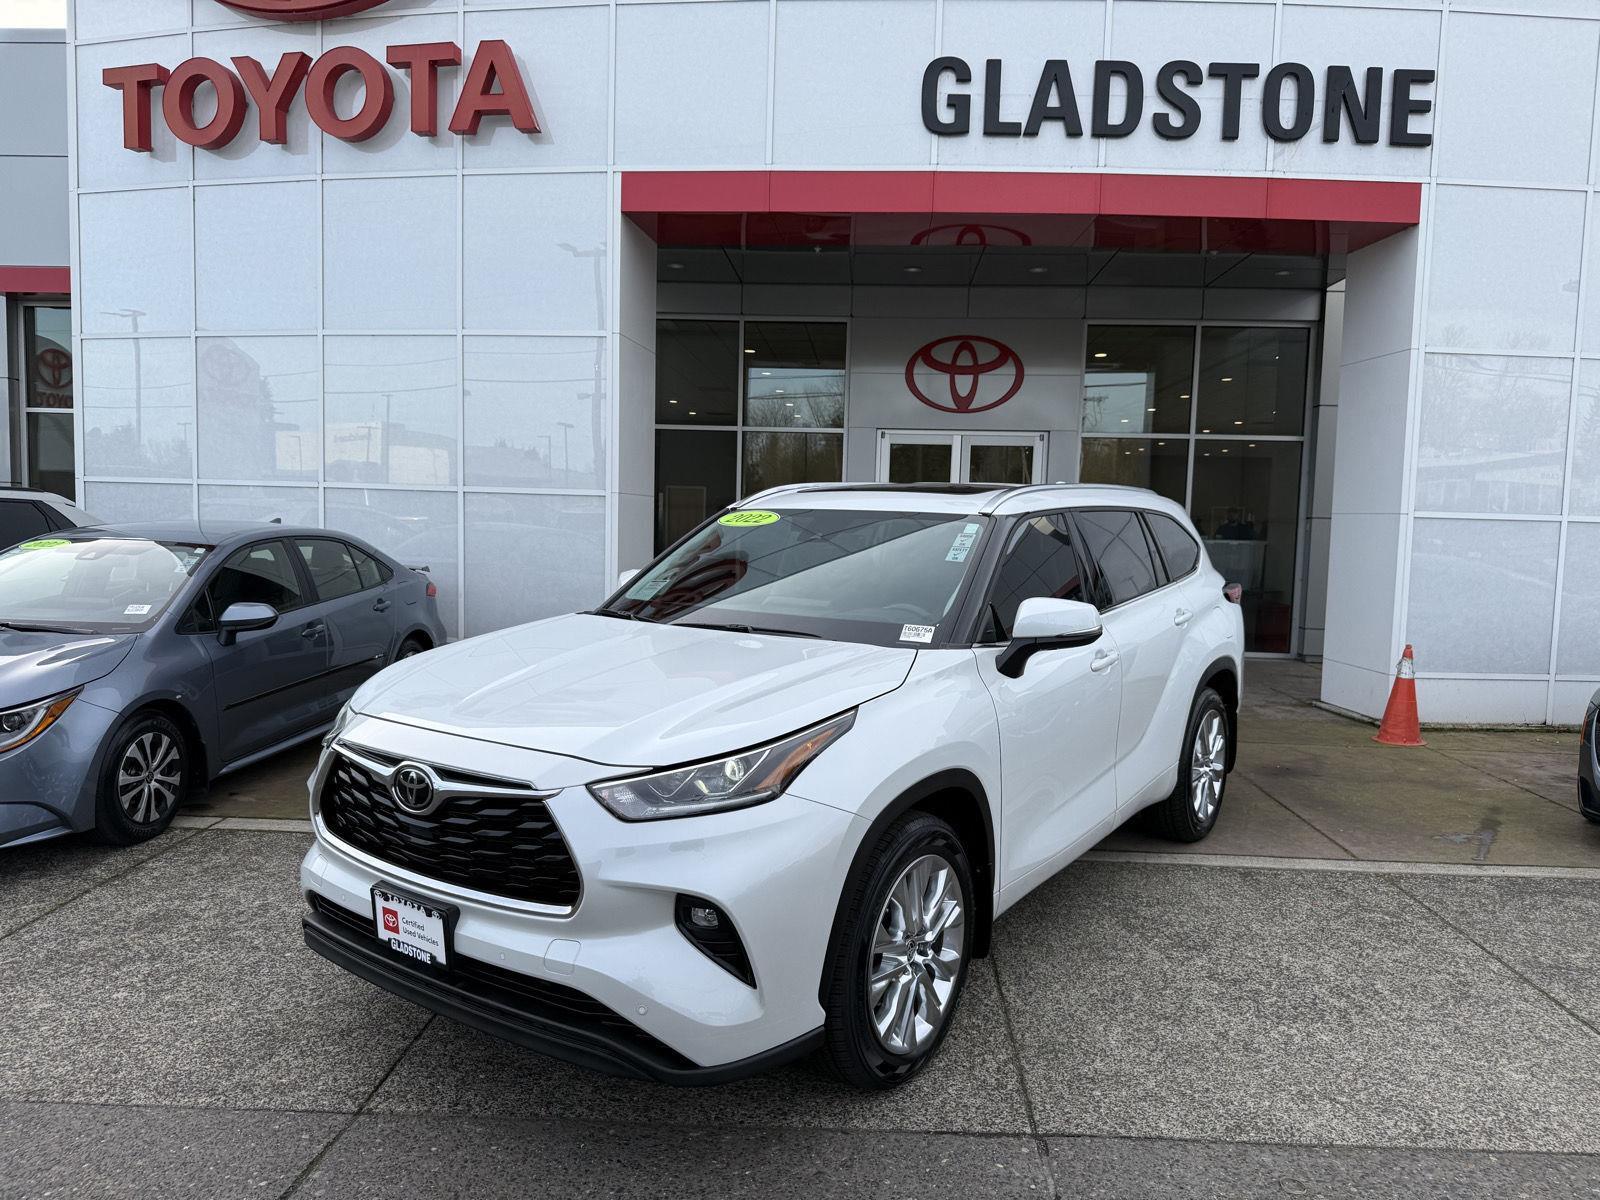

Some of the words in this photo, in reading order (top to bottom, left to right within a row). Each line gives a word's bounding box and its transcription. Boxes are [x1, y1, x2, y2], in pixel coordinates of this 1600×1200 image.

[102, 39, 542, 153] TOYOTA
[921, 56, 1435, 147] GLADSTONE
[724, 513, 773, 524] 2022
[401, 916, 425, 932] Certified
[402, 926, 417, 938] Used
[416, 930, 440, 947] Vehicles
[390, 938, 432, 965] GLADSTONE
